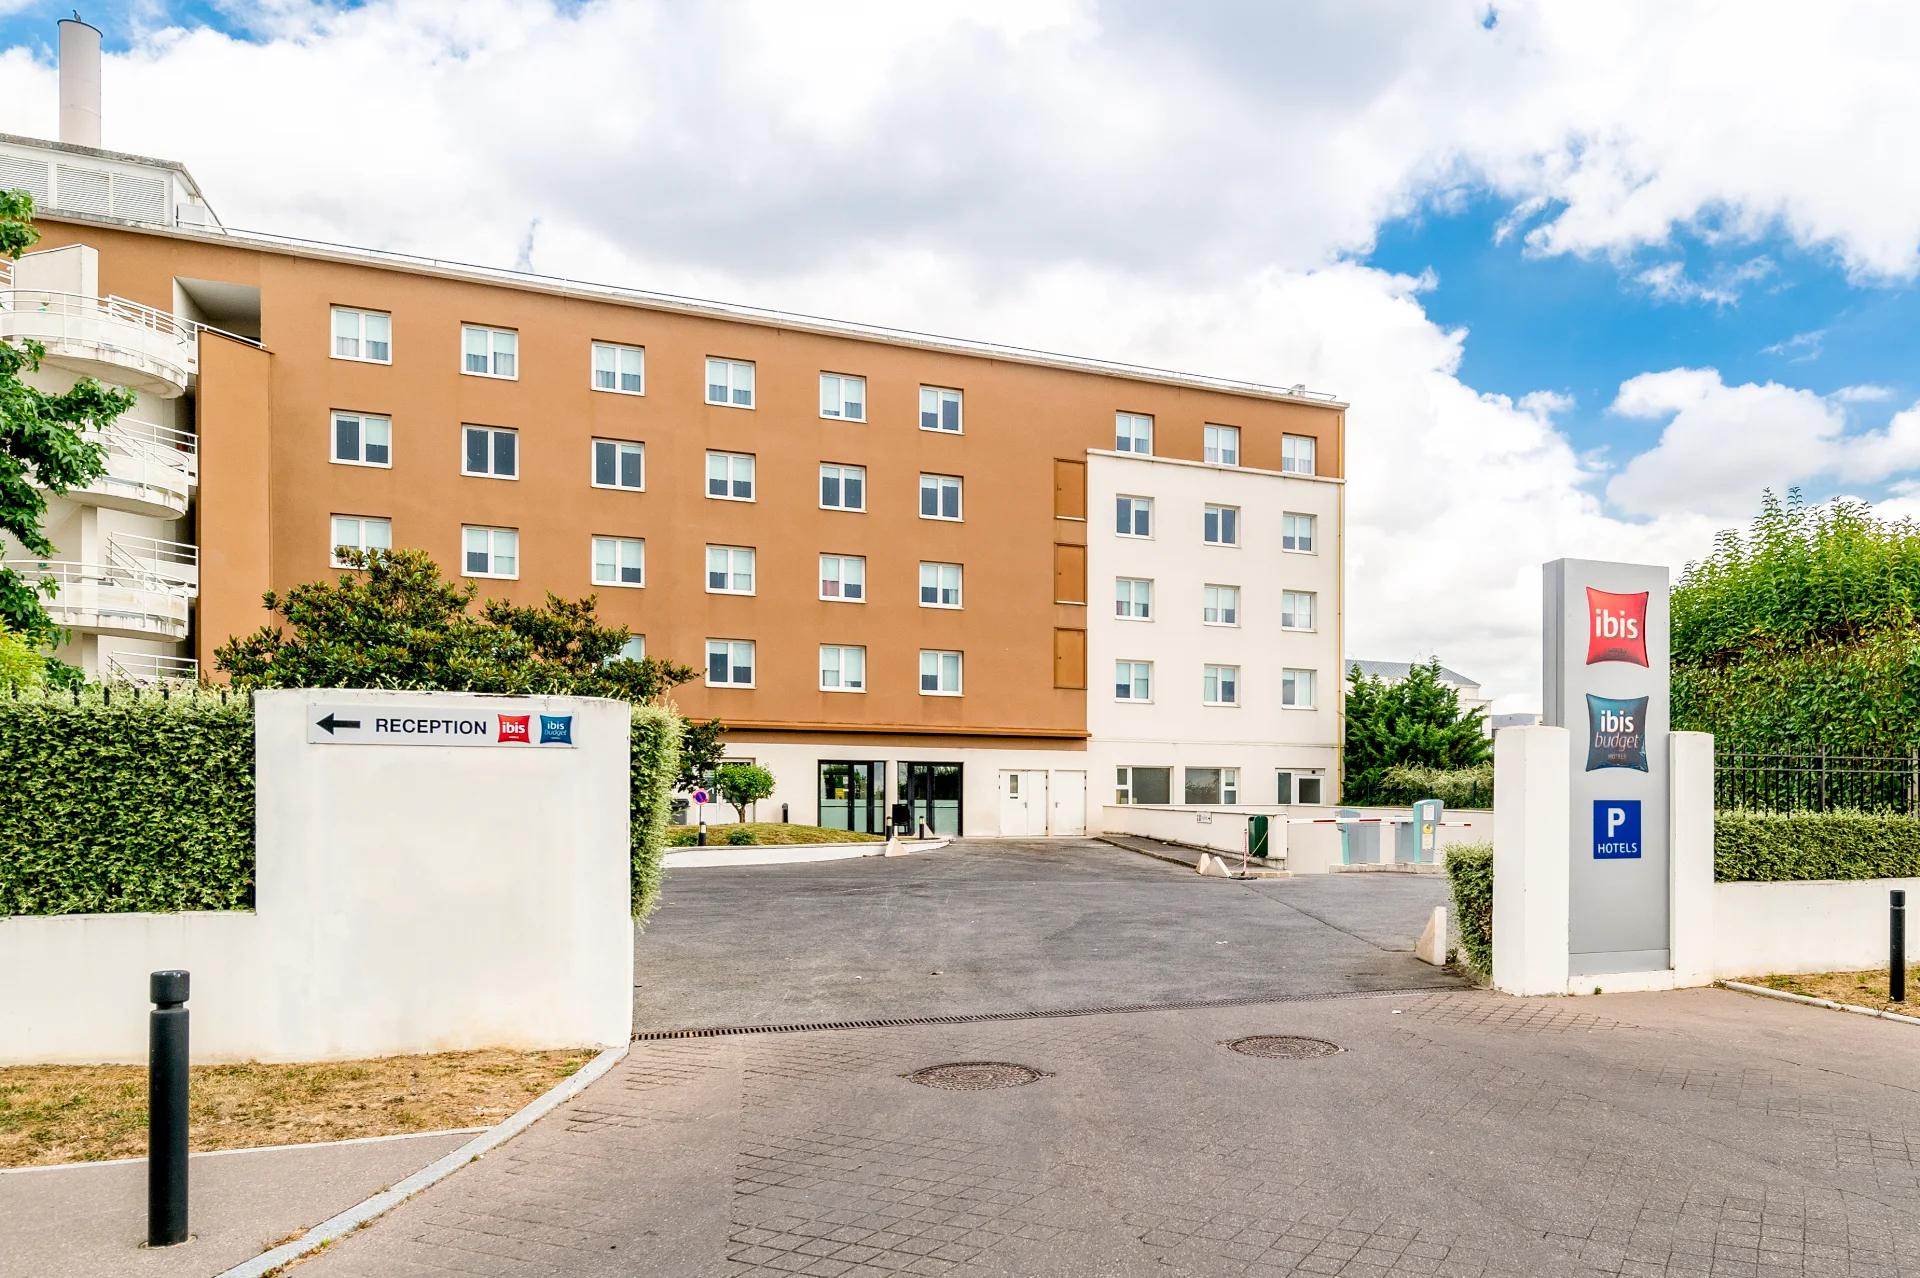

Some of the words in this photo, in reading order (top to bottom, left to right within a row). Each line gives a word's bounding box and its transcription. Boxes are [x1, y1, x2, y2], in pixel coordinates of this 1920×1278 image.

[1595, 609, 1638, 639] ibis
[375, 718, 487, 735] RECEPTION
[502, 722, 526, 734] ibis
[547, 721, 565, 730] ibis
[1601, 710, 1635, 733] ibis
[1594, 732, 1639, 751] budget
[1608, 808, 1626, 838] P
[1597, 842, 1638, 854] HOTELS
